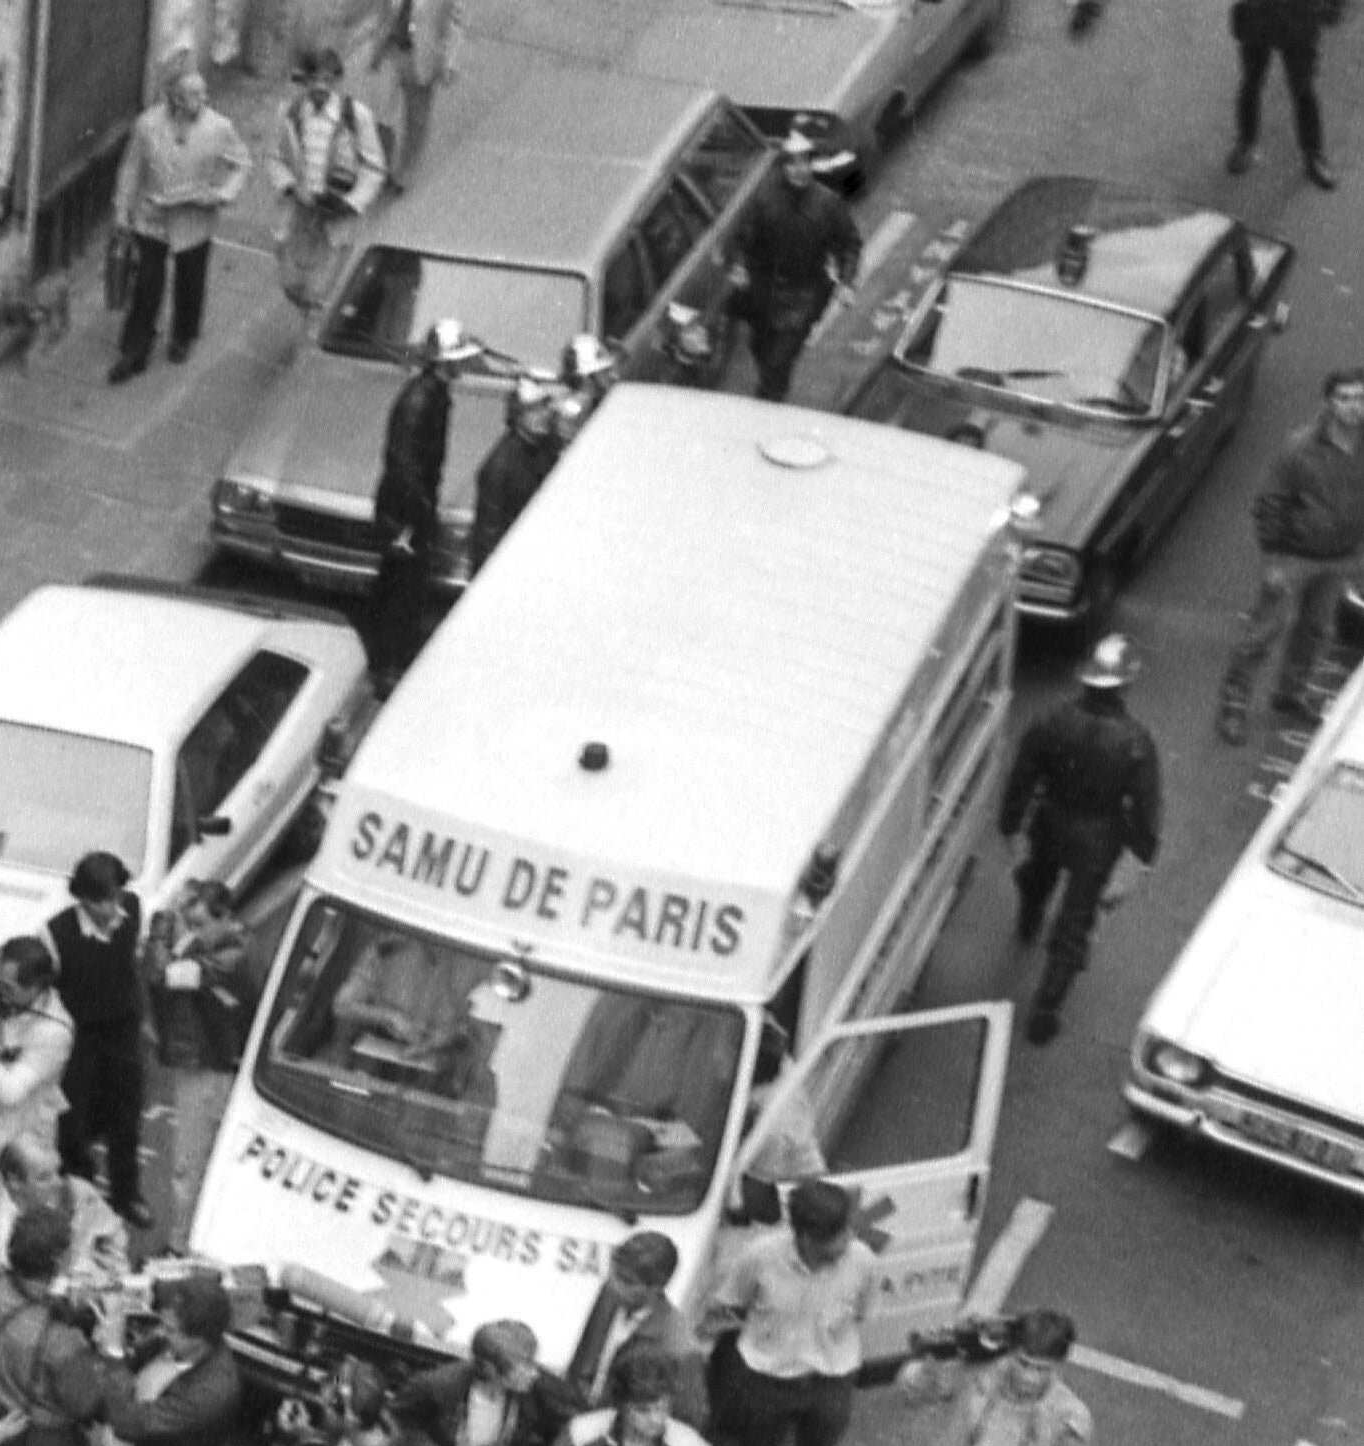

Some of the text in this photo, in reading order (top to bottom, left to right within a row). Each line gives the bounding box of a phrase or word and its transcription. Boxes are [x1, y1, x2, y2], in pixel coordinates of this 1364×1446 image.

[350, 811, 745, 957] SAMU DE PARIS
[237, 1133, 362, 1213] POLICE
[371, 1191, 542, 1267] SECOURS
